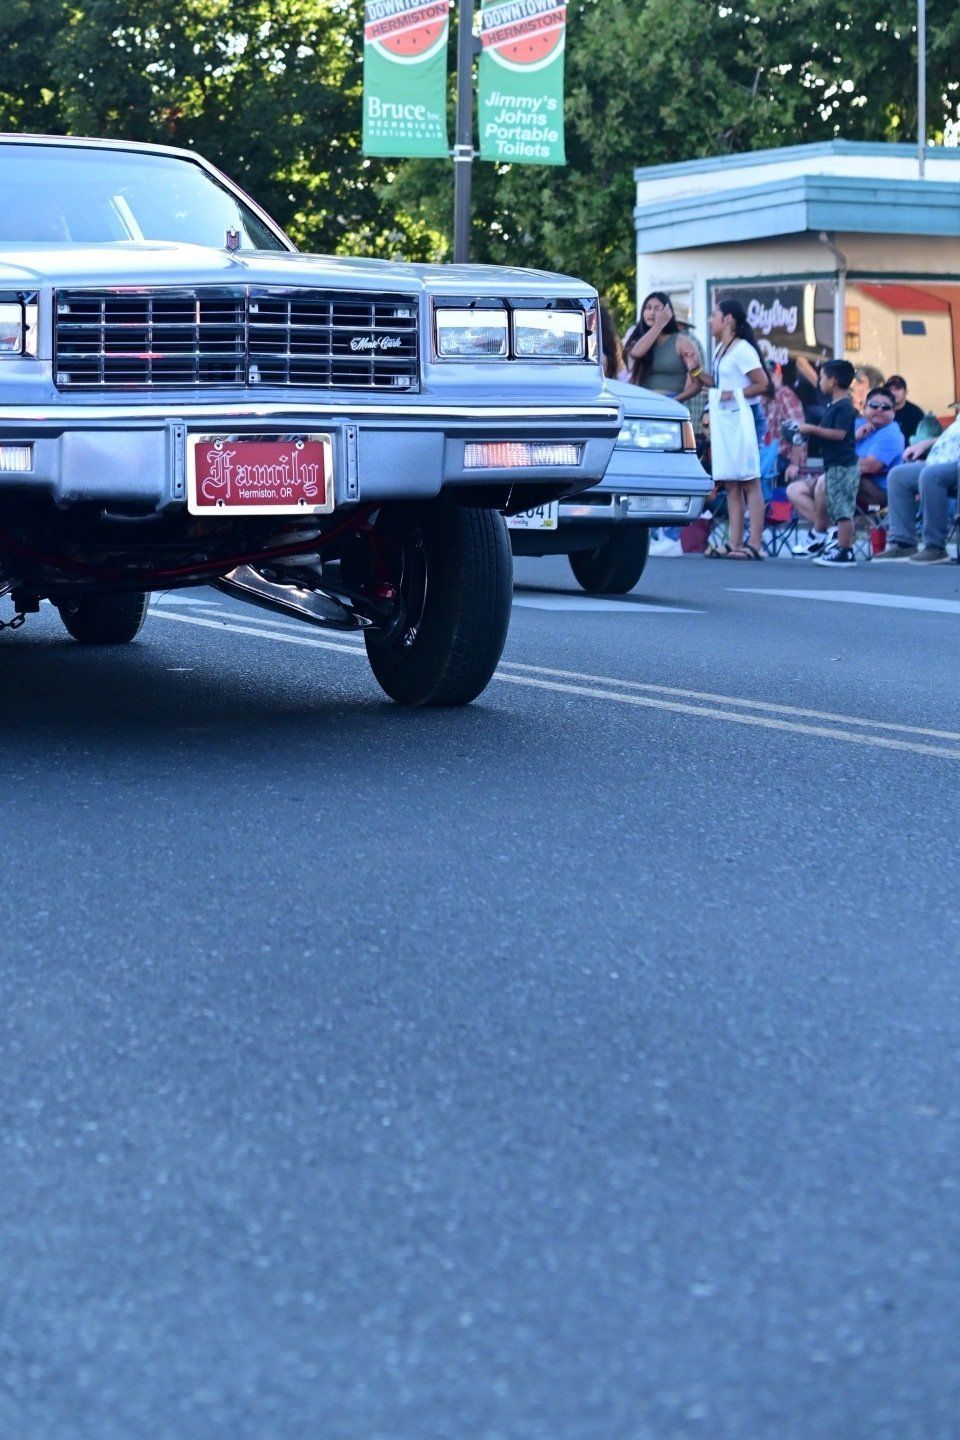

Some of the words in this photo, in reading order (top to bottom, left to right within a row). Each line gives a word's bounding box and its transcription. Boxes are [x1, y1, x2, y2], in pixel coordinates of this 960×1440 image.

[371, 3, 448, 37] HERMISTON
[487, 11, 564, 44] HERMISTON
[368, 96, 426, 120] Bruce
[484, 92, 558, 111] Jimmy's
[368, 120, 441, 131] MECHANICAL
[494, 109, 548, 126] Johns
[368, 129, 413, 138] HEATING
[425, 131, 443, 139] AIR
[485, 123, 559, 142] Portable
[496, 140, 551, 157] Toilets
[746, 299, 798, 335] Styling
[350, 337, 378, 351] Monte
[378, 335, 402, 349] Carlo
[202, 449, 319, 499] Family
[238, 488, 279, 499] Hermiston,
[280, 487, 293, 498] OR
